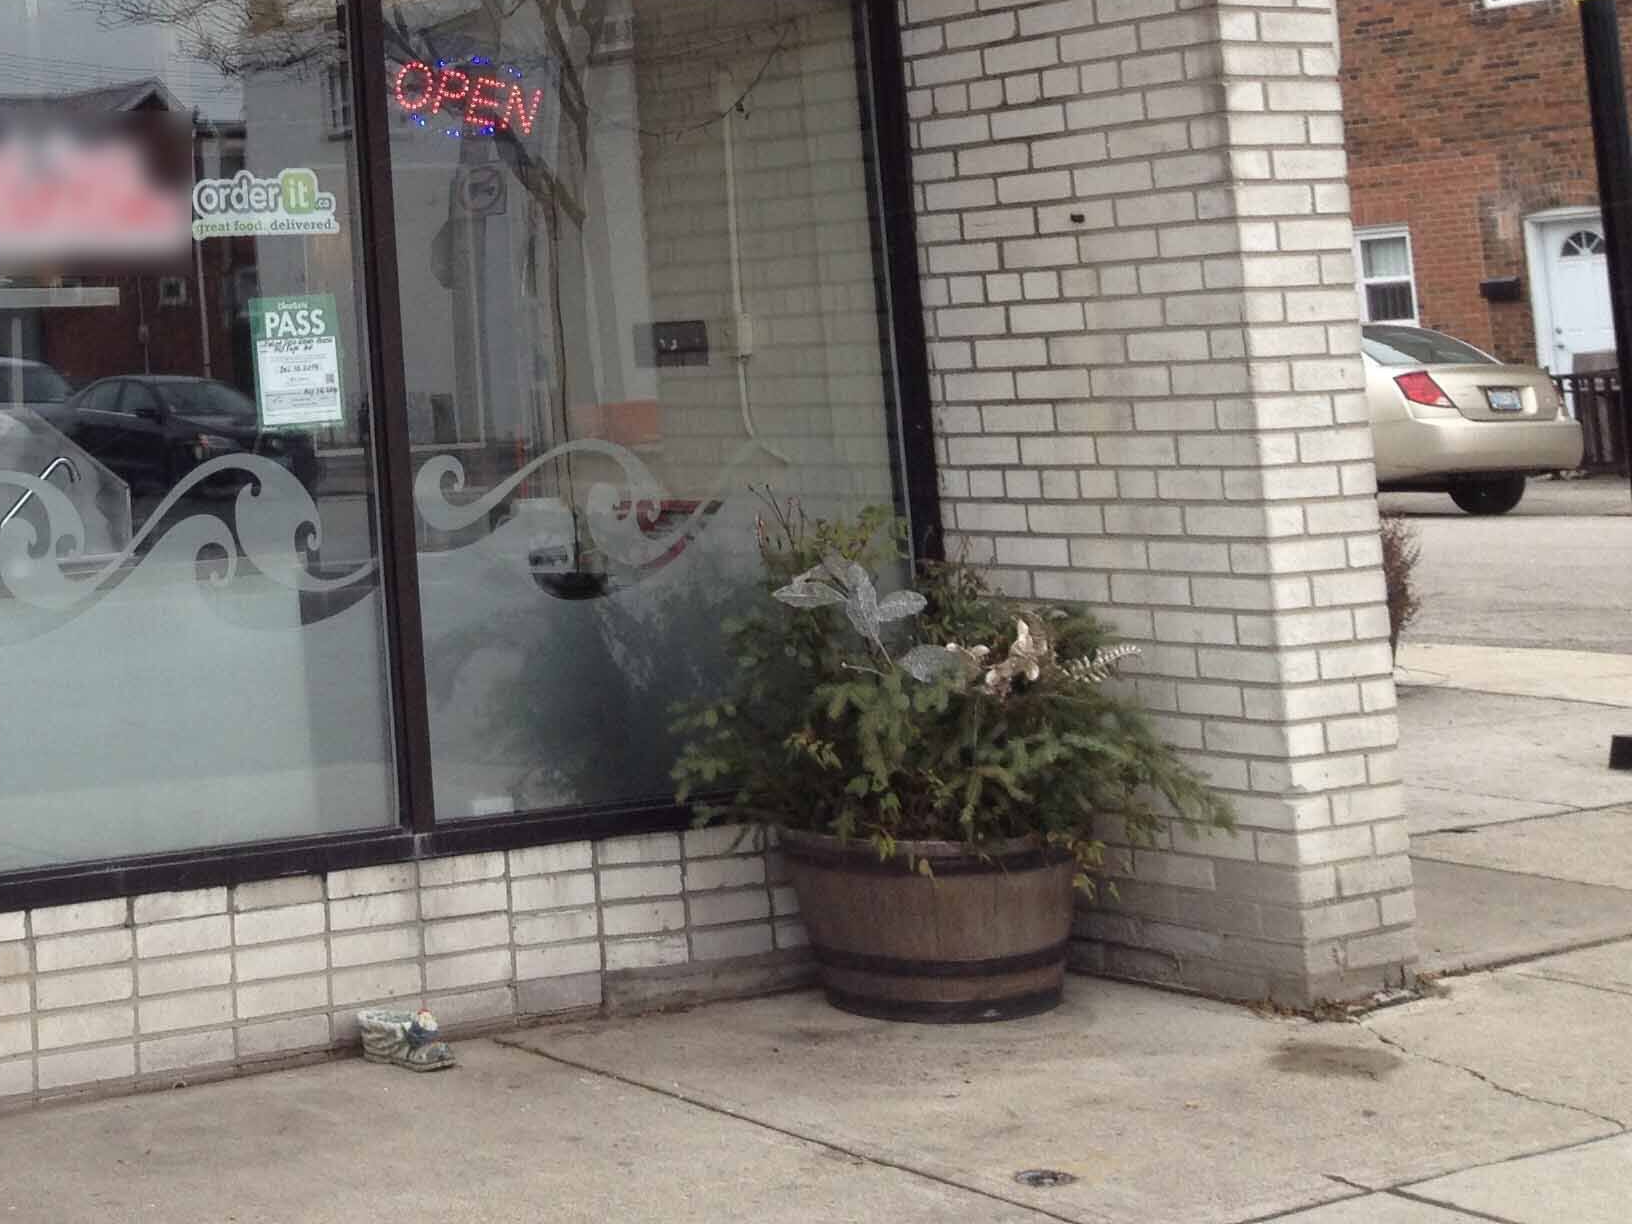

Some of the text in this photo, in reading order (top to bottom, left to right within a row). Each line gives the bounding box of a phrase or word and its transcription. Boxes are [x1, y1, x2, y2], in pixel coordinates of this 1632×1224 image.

[395, 60, 543, 135] OPEN
[196, 222, 231, 235] great
[264, 308, 326, 338] PASS
